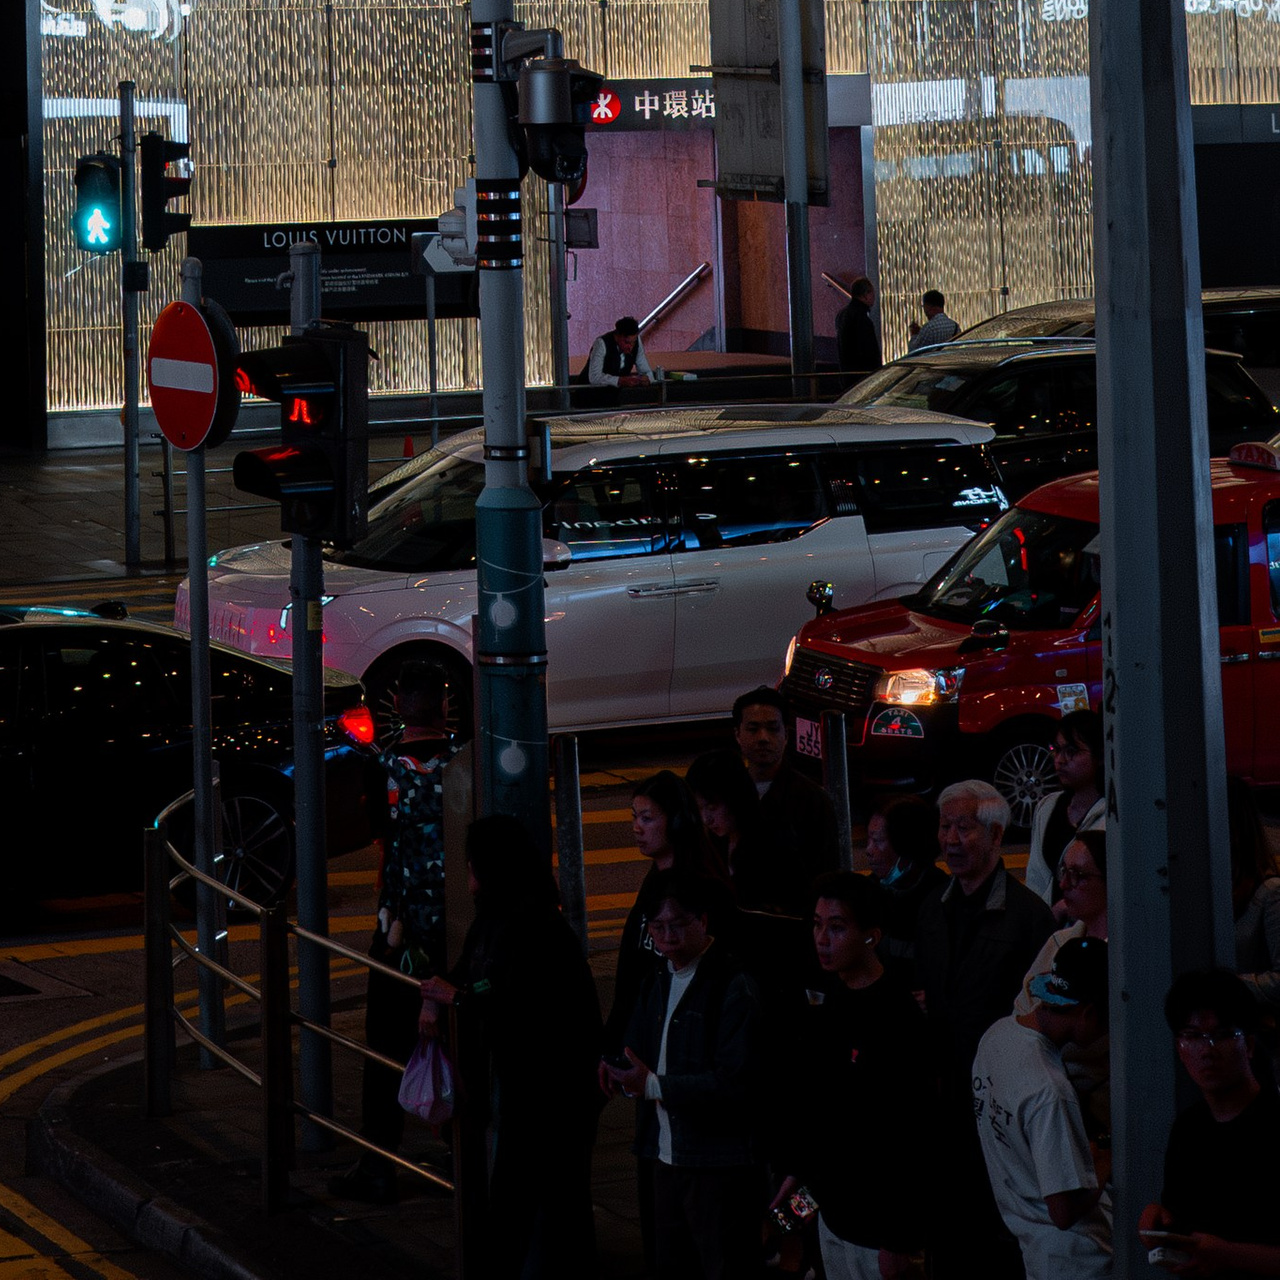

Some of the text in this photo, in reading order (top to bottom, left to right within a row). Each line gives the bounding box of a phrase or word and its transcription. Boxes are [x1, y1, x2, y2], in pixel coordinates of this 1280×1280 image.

[634, 89, 716, 120] 中環站
[264, 227, 407, 249] LOUIS VUITTON
[1232, 443, 1273, 466] TAXI
[888, 708, 908, 718] TAXI
[891, 716, 901, 726] 4
[881, 727, 913, 735] SEATS
